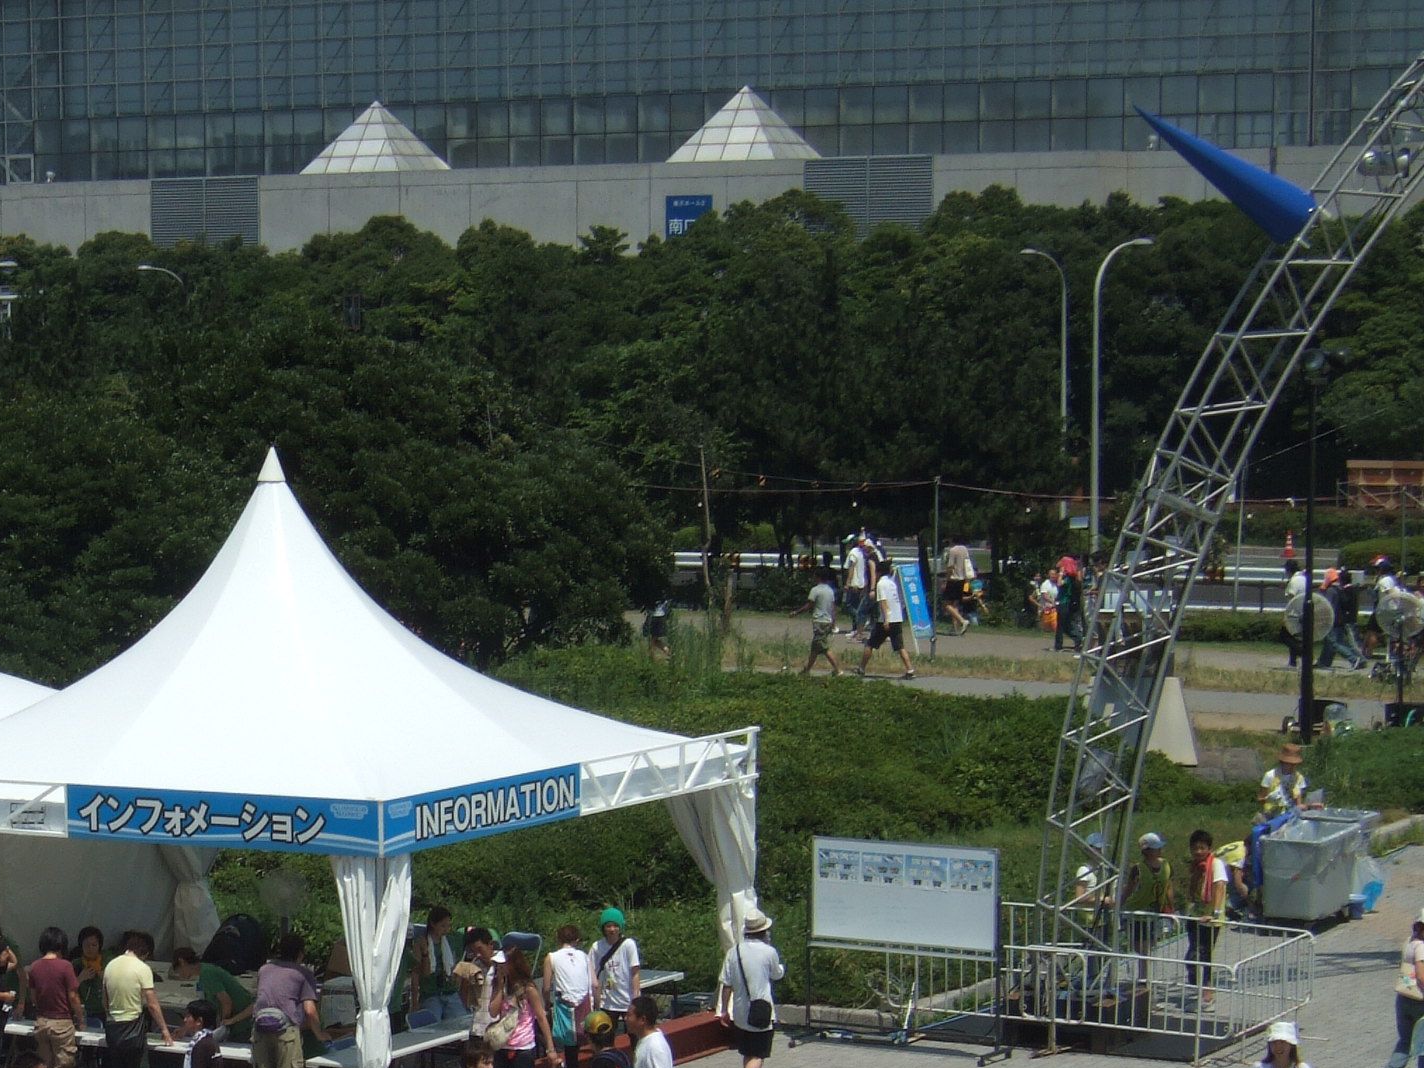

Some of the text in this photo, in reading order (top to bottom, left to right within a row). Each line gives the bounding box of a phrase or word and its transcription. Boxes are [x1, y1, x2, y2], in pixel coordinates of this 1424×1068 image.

[79, 792, 326, 846] インフォメーション
[414, 773, 576, 841] INFORMATION
